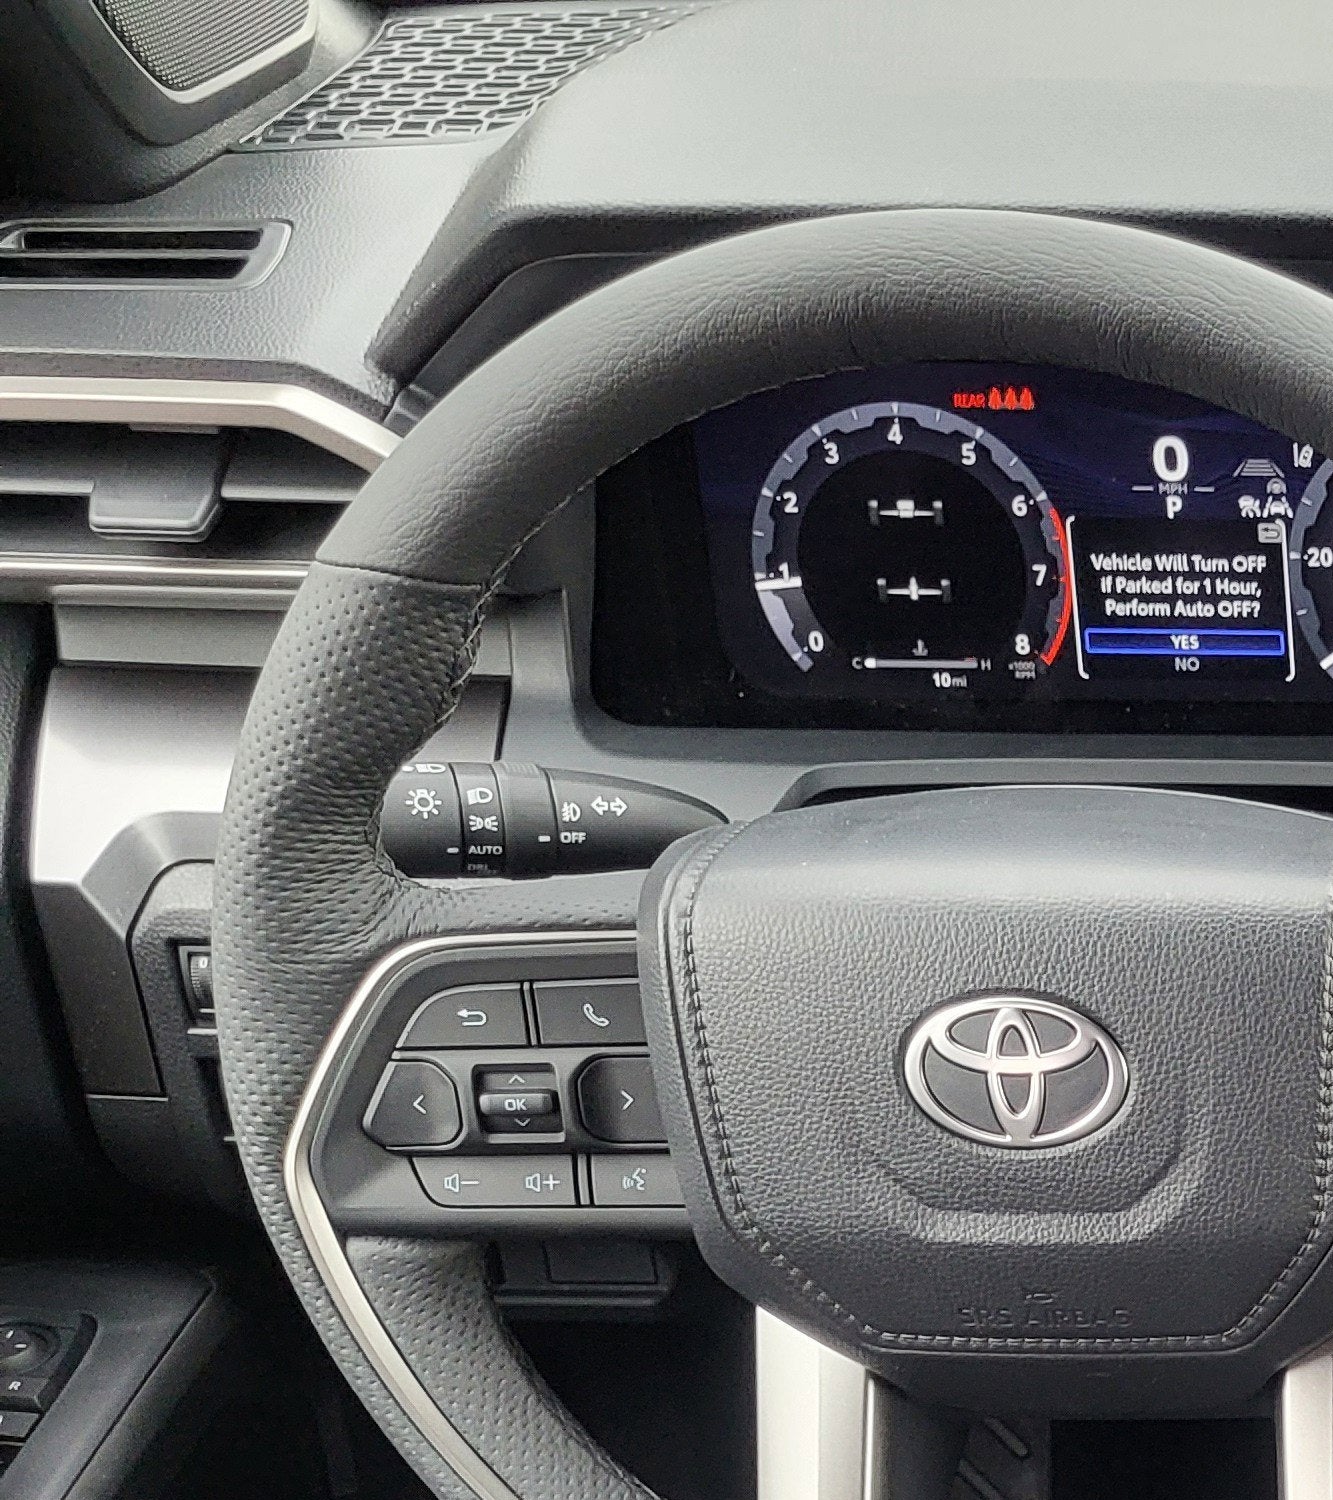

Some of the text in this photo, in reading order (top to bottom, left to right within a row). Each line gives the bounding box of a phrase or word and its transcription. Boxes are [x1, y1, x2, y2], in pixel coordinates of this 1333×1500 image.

[888, 424, 903, 445] 4
[825, 442, 840, 465] 3
[961, 441, 977, 465] 5
[1153, 435, 1189, 481] 0
[1158, 483, 1188, 494] MPH
[784, 492, 799, 513] 2
[1011, 495, 1028, 517] 6
[1166, 495, 1182, 519] P
[1090, 552, 1266, 573] Vehicle Will Turn OFF
[1307, 547, 1333, 568] 20
[779, 562, 790, 580] 1
[1032, 564, 1047, 586] 7
[1115, 576, 1172, 595] Parked
[1175, 577, 1200, 595] for
[1203, 578, 1211, 594] 1
[1215, 578, 1261, 598] Hour,
[1105, 598, 1260, 618] Perform Auto OFF?
[808, 631, 824, 652] 0
[1014, 634, 1031, 655] 8
[1170, 635, 1199, 649] YES
[851, 657, 863, 670] C
[981, 658, 992, 670] H
[1174, 657, 1199, 671] NO
[560, 832, 586, 844] OFF
[468, 845, 502, 855] AUTO
[504, 1099, 527, 1111] OK
